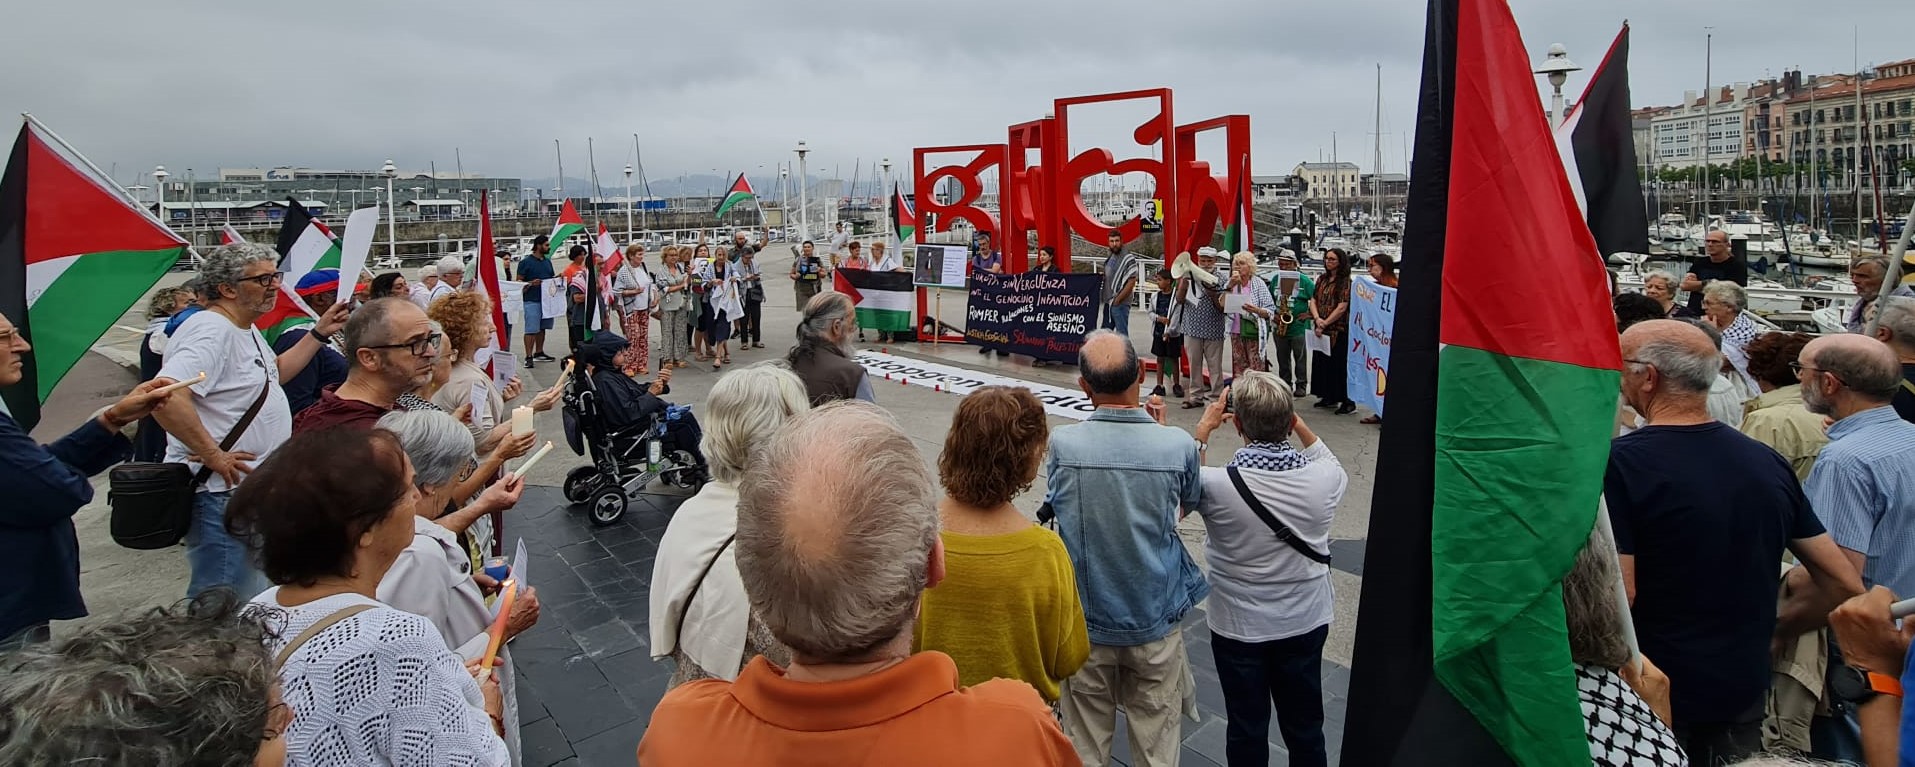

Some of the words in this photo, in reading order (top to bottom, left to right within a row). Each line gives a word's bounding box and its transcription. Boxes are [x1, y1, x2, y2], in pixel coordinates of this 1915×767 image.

[1037, 292, 1089, 307] INFANTICIDA
[1380, 291, 1391, 313] EL
[969, 305, 999, 323] ROMPER
[1023, 314, 1035, 323] CON
[1036, 312, 1045, 322] EL
[1048, 312, 1085, 325] SIONISMO
[1046, 323, 1086, 335] ASESINO
